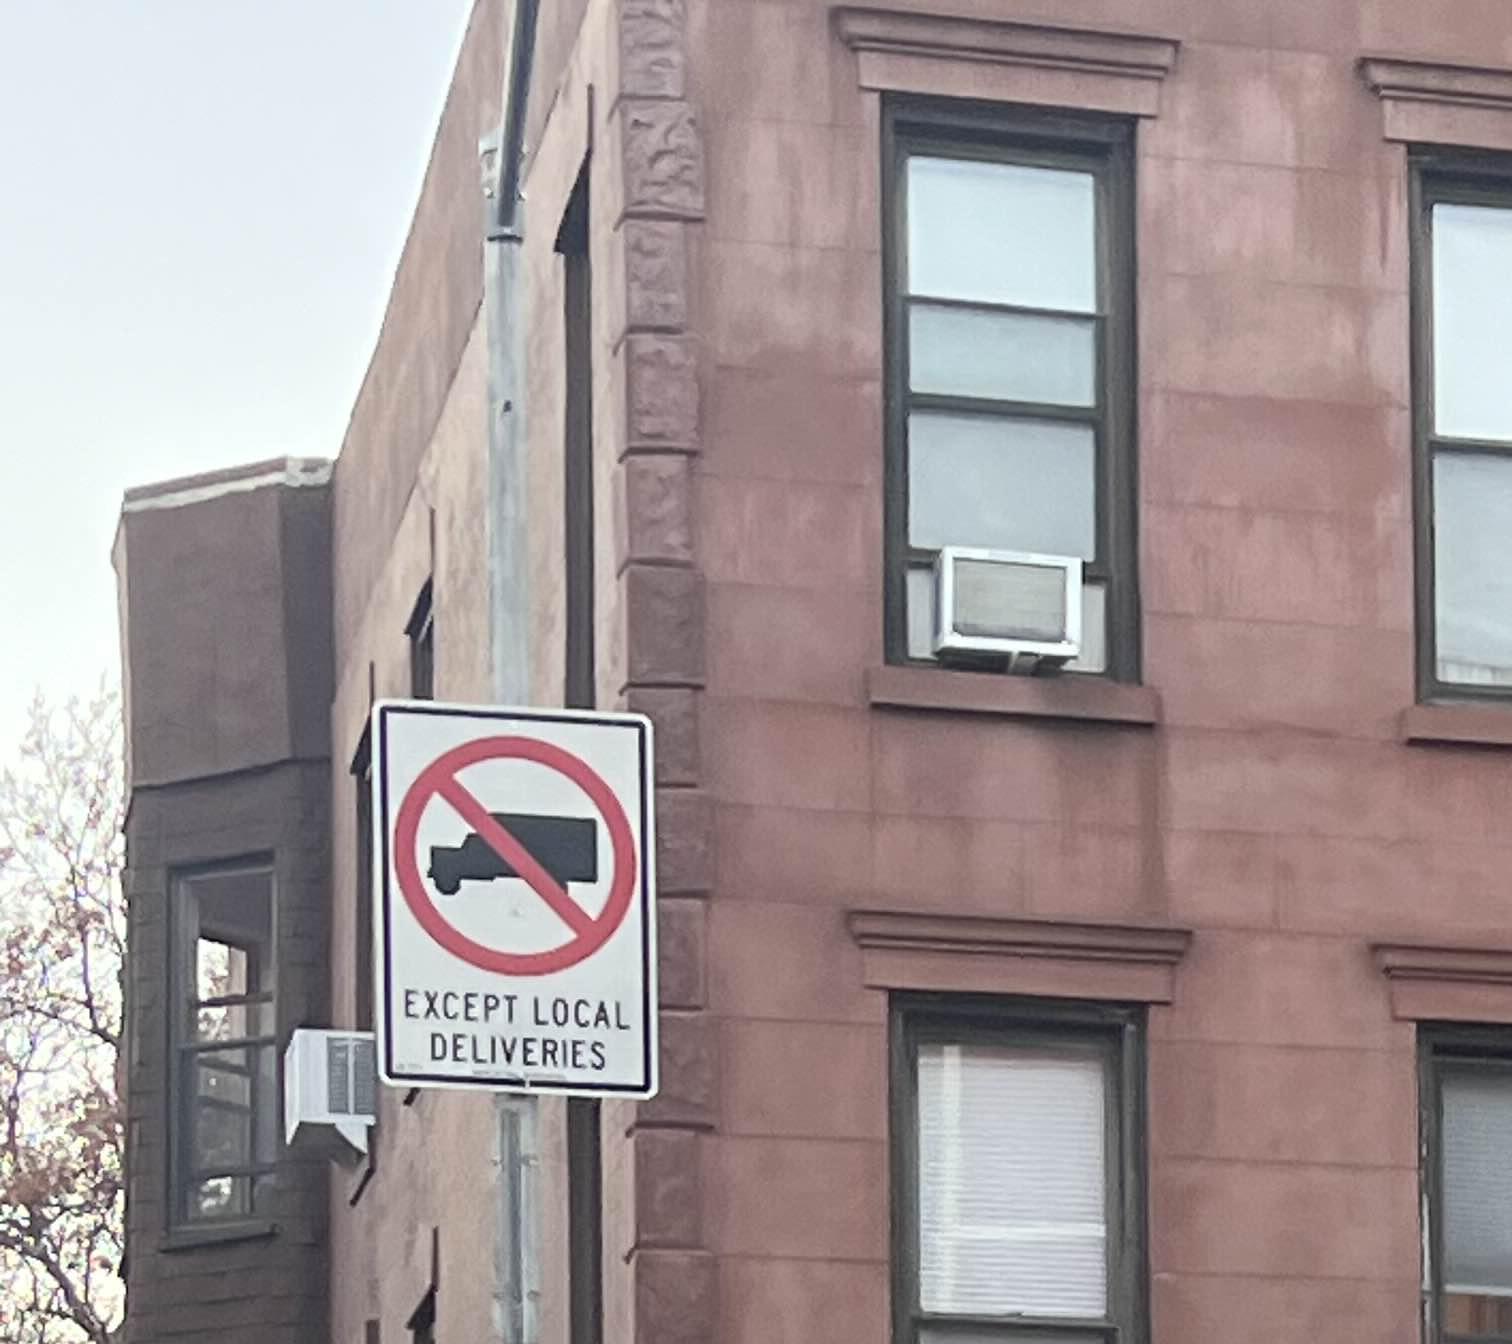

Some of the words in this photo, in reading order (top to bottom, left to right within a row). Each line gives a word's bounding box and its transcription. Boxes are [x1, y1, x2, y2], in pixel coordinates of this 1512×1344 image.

[404, 988, 518, 1025] EXCEPT
[533, 996, 631, 1031] LOCAL
[430, 1033, 606, 1071] DELIVERIES
